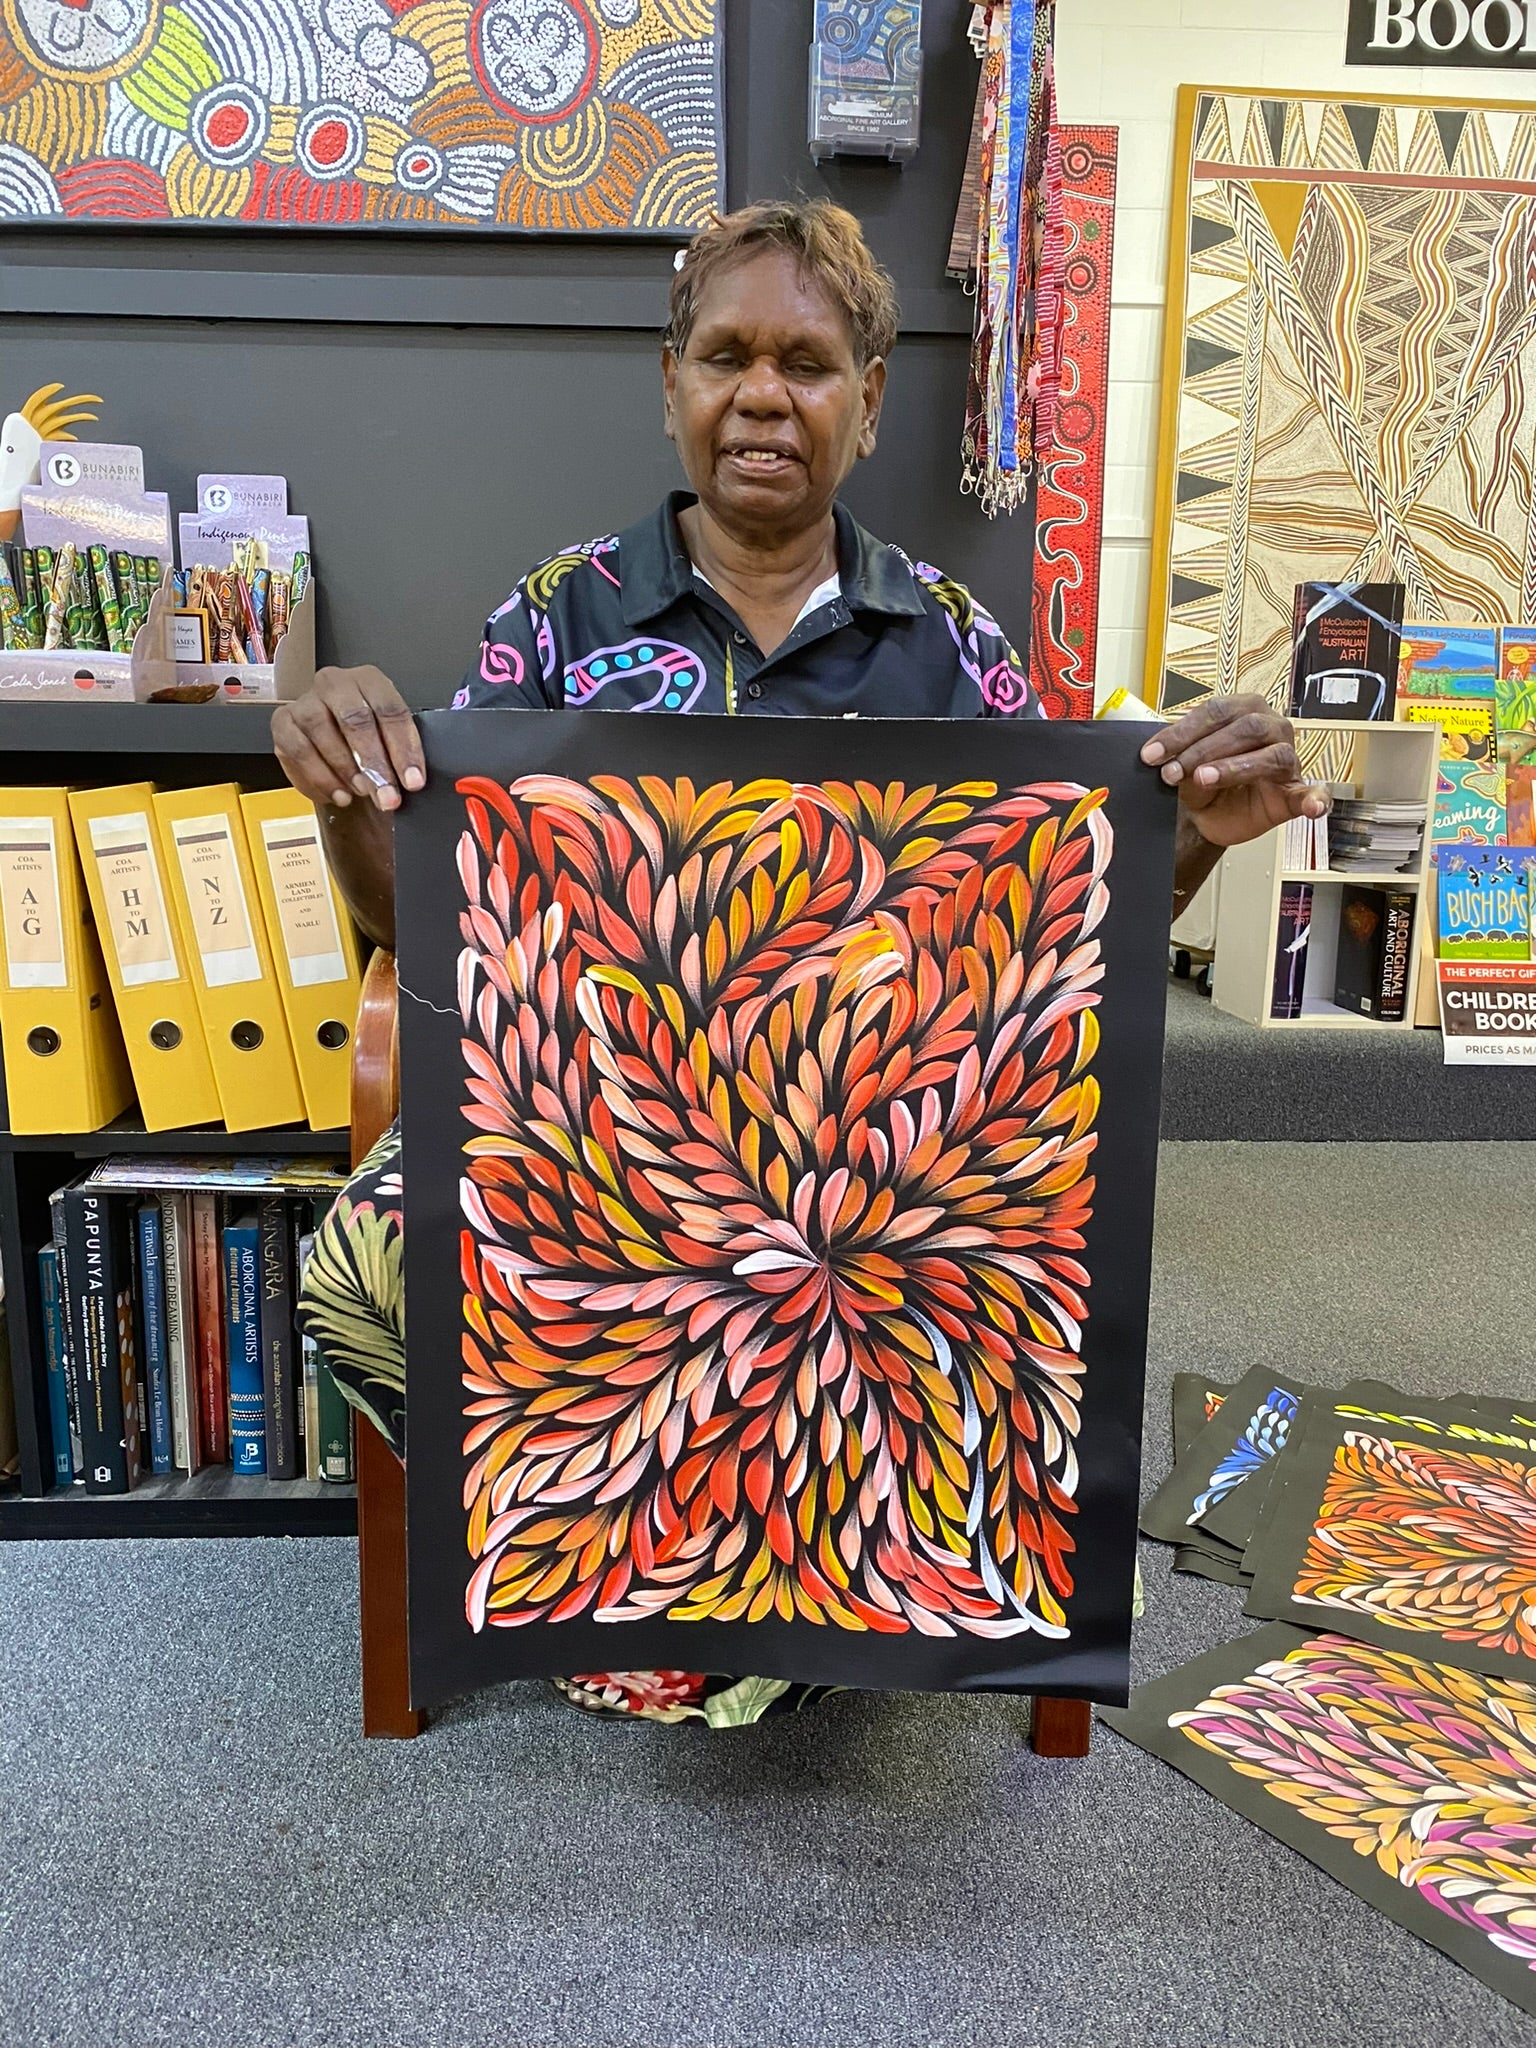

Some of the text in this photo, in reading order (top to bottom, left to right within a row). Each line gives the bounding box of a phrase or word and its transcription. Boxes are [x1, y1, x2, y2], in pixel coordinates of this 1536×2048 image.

[1367, 0, 1536, 52] BOO
[819, 115, 853, 124] ABORIGINAL
[82, 463, 139, 475] BUNABIRI
[233, 492, 283, 501] BUNABIRI
[1323, 617, 1367, 626] McCulloch's
[1323, 627, 1367, 636] Encyclopedia
[1420, 630, 1435, 638] The
[1436, 631, 1472, 640] Lightning
[1322, 638, 1366, 647] AUSTRALIAN
[1339, 649, 1364, 660] ART
[33, 671, 67, 690] Jones
[1420, 714, 1485, 727] Noisy Nature
[1433, 802, 1501, 832] eaming
[115, 858, 132, 866] COA
[192, 853, 222, 864] ARTISTS
[281, 858, 311, 868] ARTISTS
[286, 851, 302, 859] COA
[110, 866, 141, 875] ARTISTS
[202, 876, 221, 896] N
[284, 880, 316, 890] ARNHEM
[291, 887, 312, 896] LAND
[21, 887, 38, 905] A
[121, 888, 141, 908] H
[281, 893, 324, 904] COLLECTIBLES
[210, 907, 228, 926] Z
[1447, 887, 1529, 929] BUSH BAS
[23, 918, 41, 936] G
[295, 920, 321, 929] WARLU
[1293, 917, 1310, 926] ART
[1387, 908, 1398, 928] ART
[125, 918, 150, 938] M
[1385, 929, 1396, 953] AND
[1391, 908, 1410, 998] ABORIGINAL
[1381, 954, 1393, 998] CULTURE
[1445, 967, 1466, 977] THE
[1468, 968, 1516, 979] PERFECT
[1465, 1045, 1504, 1055] PRICES
[1506, 1046, 1521, 1055] AS
[83, 1198, 103, 1290] PAPUNYA
[145, 1219, 158, 1267] virawala
[163, 1195, 180, 1342] INDOWS ON THE DREAMING
[146, 1270, 157, 1298] painter
[229, 1247, 240, 1324] dictionary of biographies
[148, 1300, 158, 1309] of
[242, 1247, 258, 1363] ABORIGINAL ARTISTS
[45, 1306, 54, 1326] John
[149, 1311, 158, 1322] the
[150, 1325, 159, 1362] dreaming
[273, 1340, 281, 1351] the
[273, 1353, 283, 1386] australian
[153, 1368, 161, 1390] Sandra
[154, 1391, 161, 1399] Le
[273, 1386, 284, 1420] aboriginal
[155, 1418, 163, 1443] Holmes
